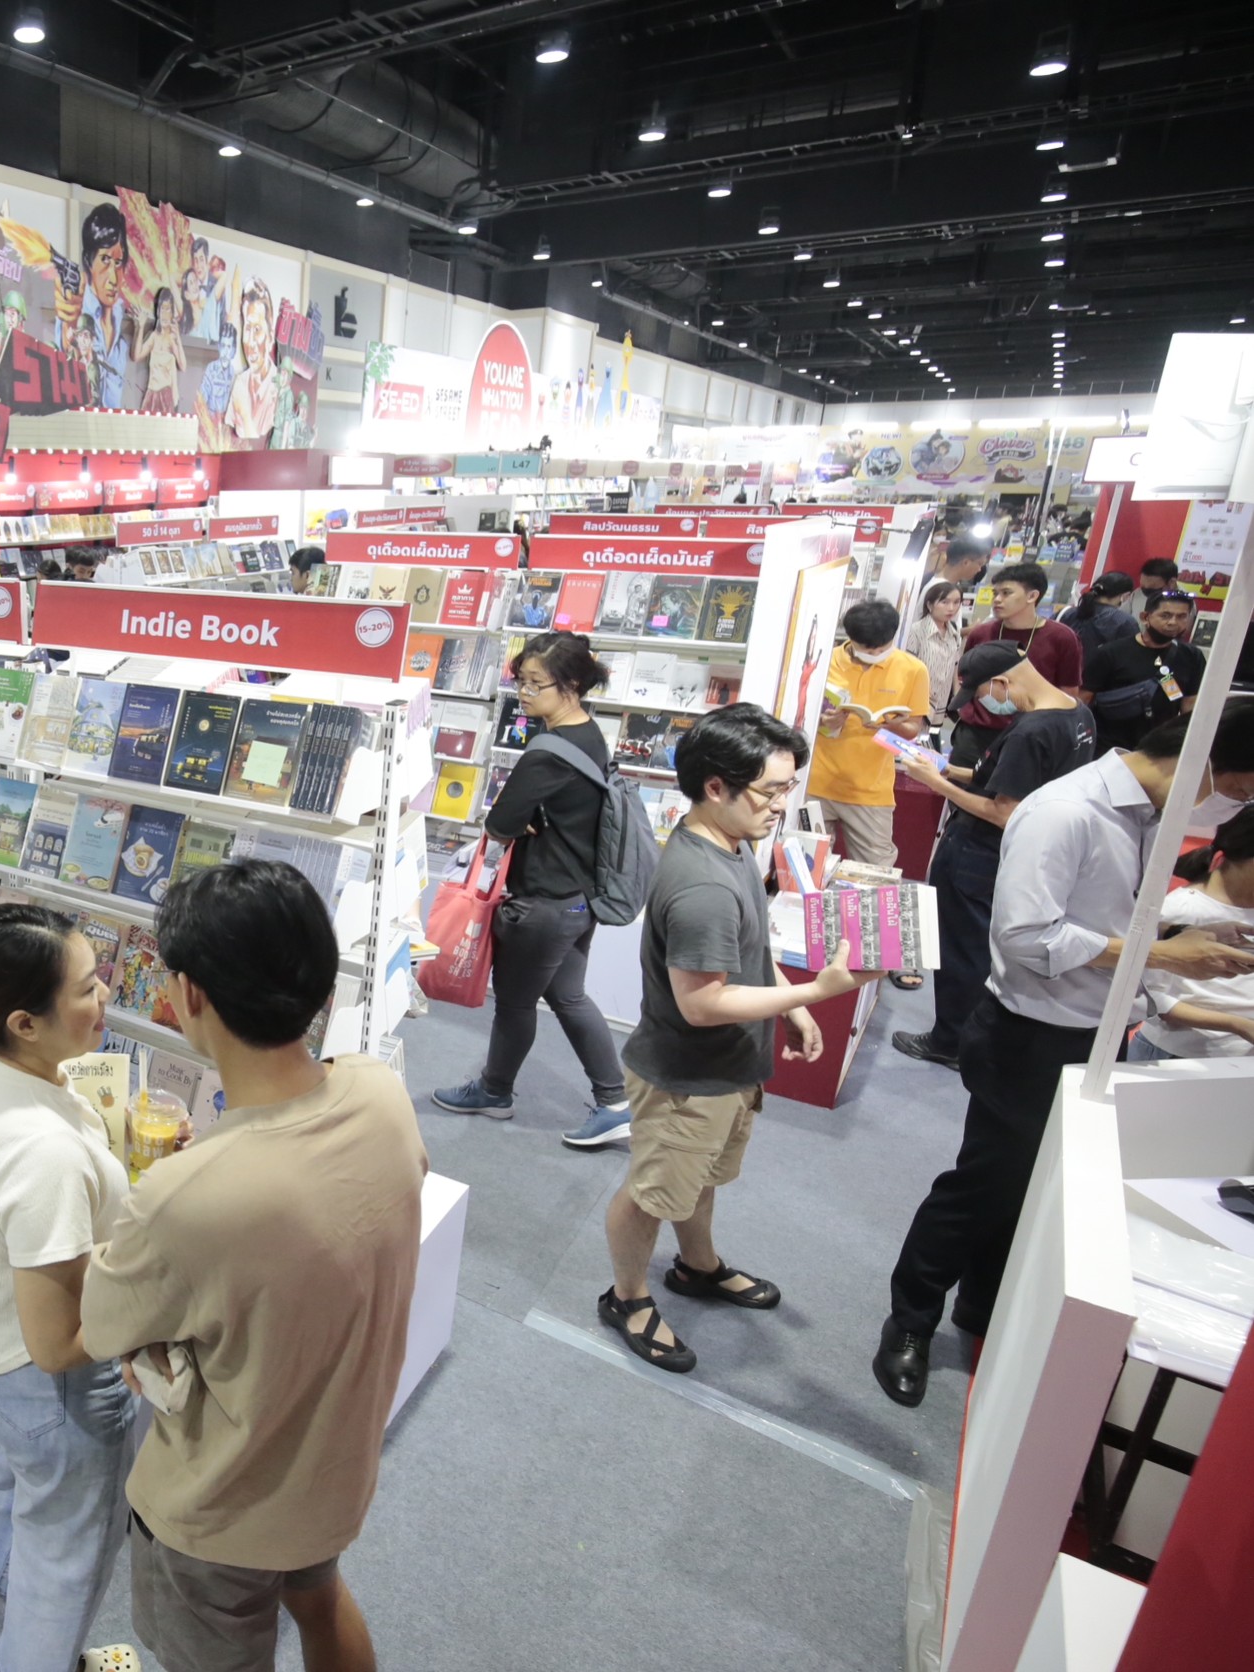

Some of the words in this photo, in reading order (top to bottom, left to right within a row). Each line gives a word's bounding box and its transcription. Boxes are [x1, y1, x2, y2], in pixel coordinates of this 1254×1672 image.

[483, 360, 506, 385] YOU
[506, 366, 525, 389] ARE
[378, 388, 421, 416] SE-ED
[435, 389, 463, 405] SESAME
[481, 388, 505, 409] WHAT
[505, 390, 524, 411] YOU
[979, 436, 1034, 454] Clover
[512, 460, 530, 470] L47
[142, 527, 152, 537] 50
[160, 526, 167, 536] 14
[583, 520, 660, 536] ศิลปวัฒนธรรม
[367, 541, 470, 560] ดุเดือดเผ็ดมันส์
[582, 550, 715, 569] ดุเดือดเผ็ดมันส์
[120, 608, 192, 639] Indie
[200, 614, 281, 648] Book
[358, 622, 391, 634] 15-20%
[847, 892, 858, 918] ในฝัน
[166, 1070, 183, 1082] Cook
[183, 1074, 193, 1086] By
